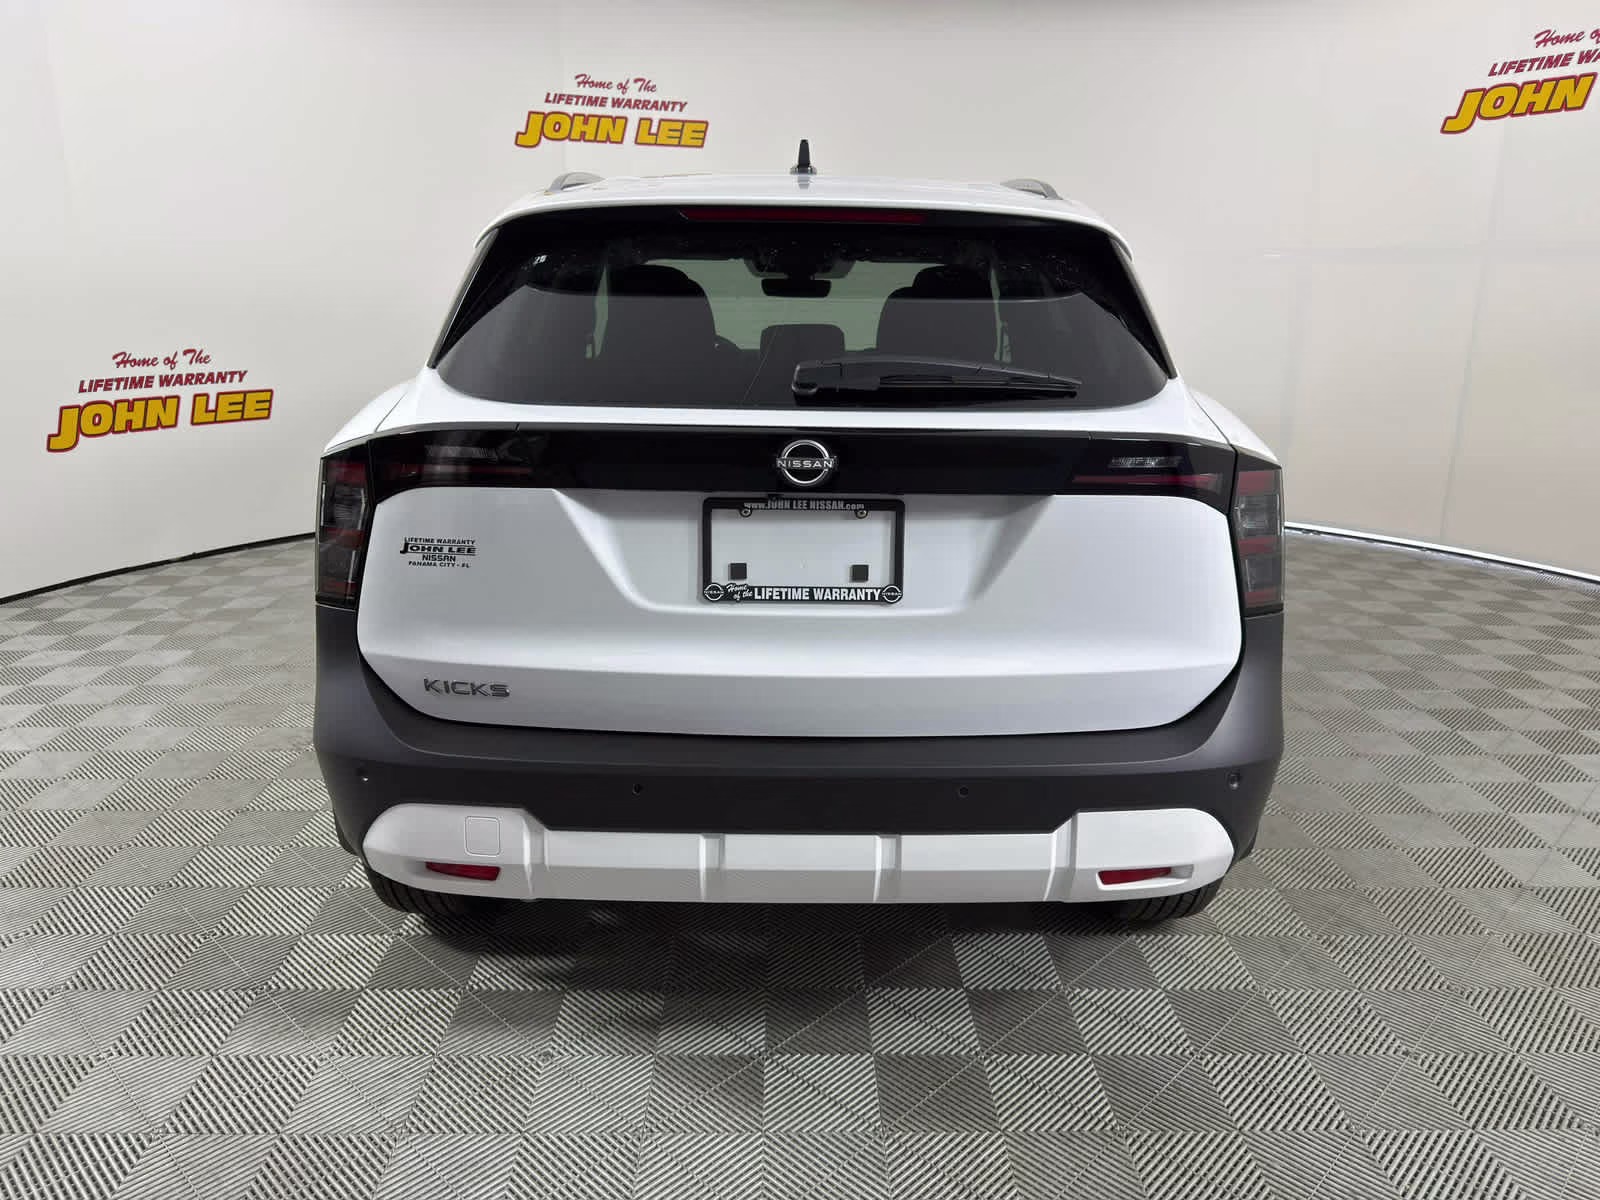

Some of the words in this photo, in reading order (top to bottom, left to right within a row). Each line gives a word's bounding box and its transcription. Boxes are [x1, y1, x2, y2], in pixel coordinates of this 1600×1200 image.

[1534, 29, 1585, 48] Home
[1488, 52, 1575, 76] LIFETIME
[574, 74, 613, 89] Home
[616, 79, 630, 95] of
[633, 78, 657, 92] The
[544, 92, 608, 107] LIFETIME
[611, 97, 688, 112] WARRANTY
[1440, 72, 1598, 134] JOHN
[515, 111, 628, 148] JOHN
[634, 117, 709, 148] LEE
[112, 351, 159, 368] Home
[163, 351, 178, 370] of
[182, 349, 211, 364] The
[78, 376, 155, 393] LIFETIME
[159, 370, 248, 387] WARRANTY
[46, 395, 181, 453] JOHN
[191, 389, 274, 425] LEE
[776, 459, 834, 468] NISSAN
[793, 500, 808, 509] LEE
[400, 542, 444, 554] JOHN
[447, 546, 477, 554] LEE
[422, 554, 456, 562] NISSAN
[726, 584, 748, 593] Home
[754, 587, 810, 600] LIFETIME
[813, 588, 881, 601] WARRANTY
[424, 678, 510, 698] KICKS
